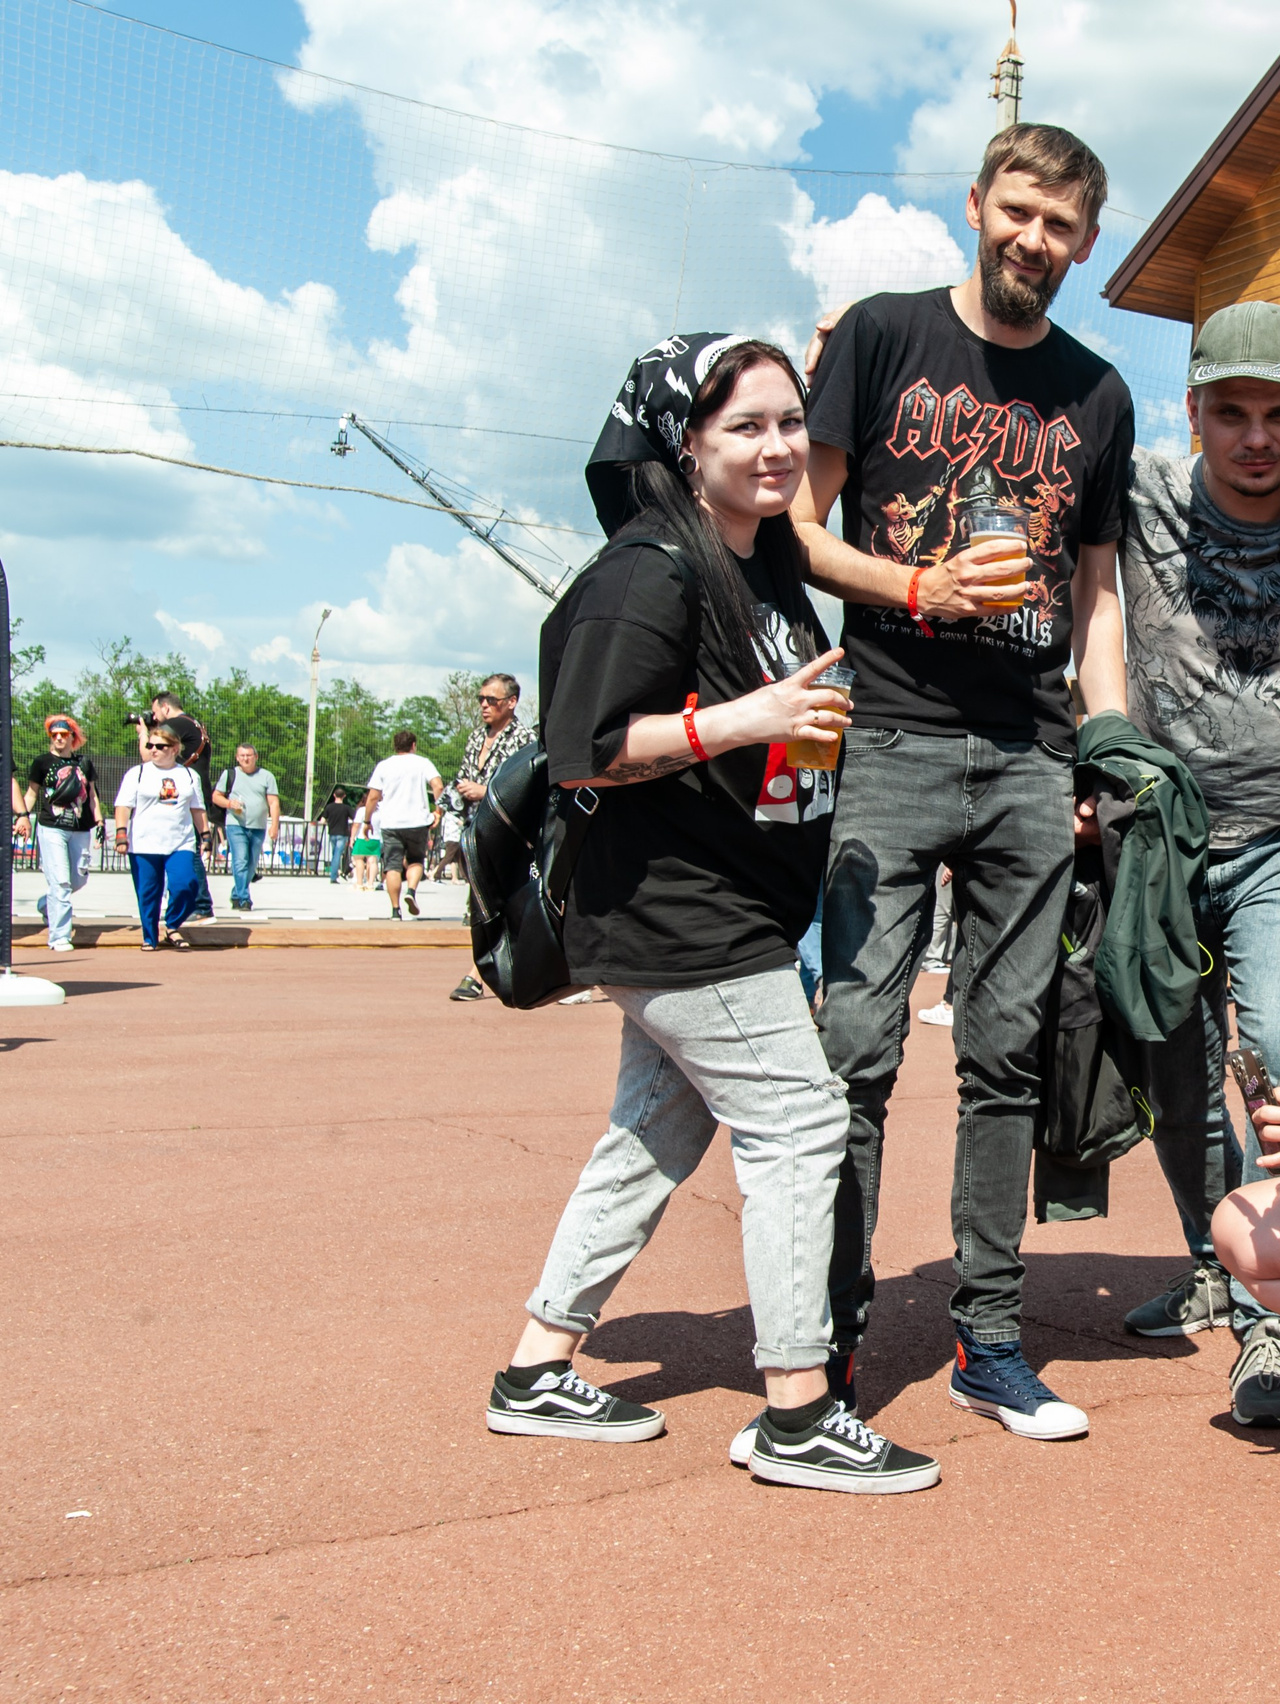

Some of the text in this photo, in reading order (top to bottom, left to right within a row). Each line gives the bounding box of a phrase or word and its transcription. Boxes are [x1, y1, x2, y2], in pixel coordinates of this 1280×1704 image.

[880, 623, 898, 633] GOT
[900, 626, 912, 634] MY
[940, 631, 968, 642] GONNA
[1008, 642, 1019, 653] TO
